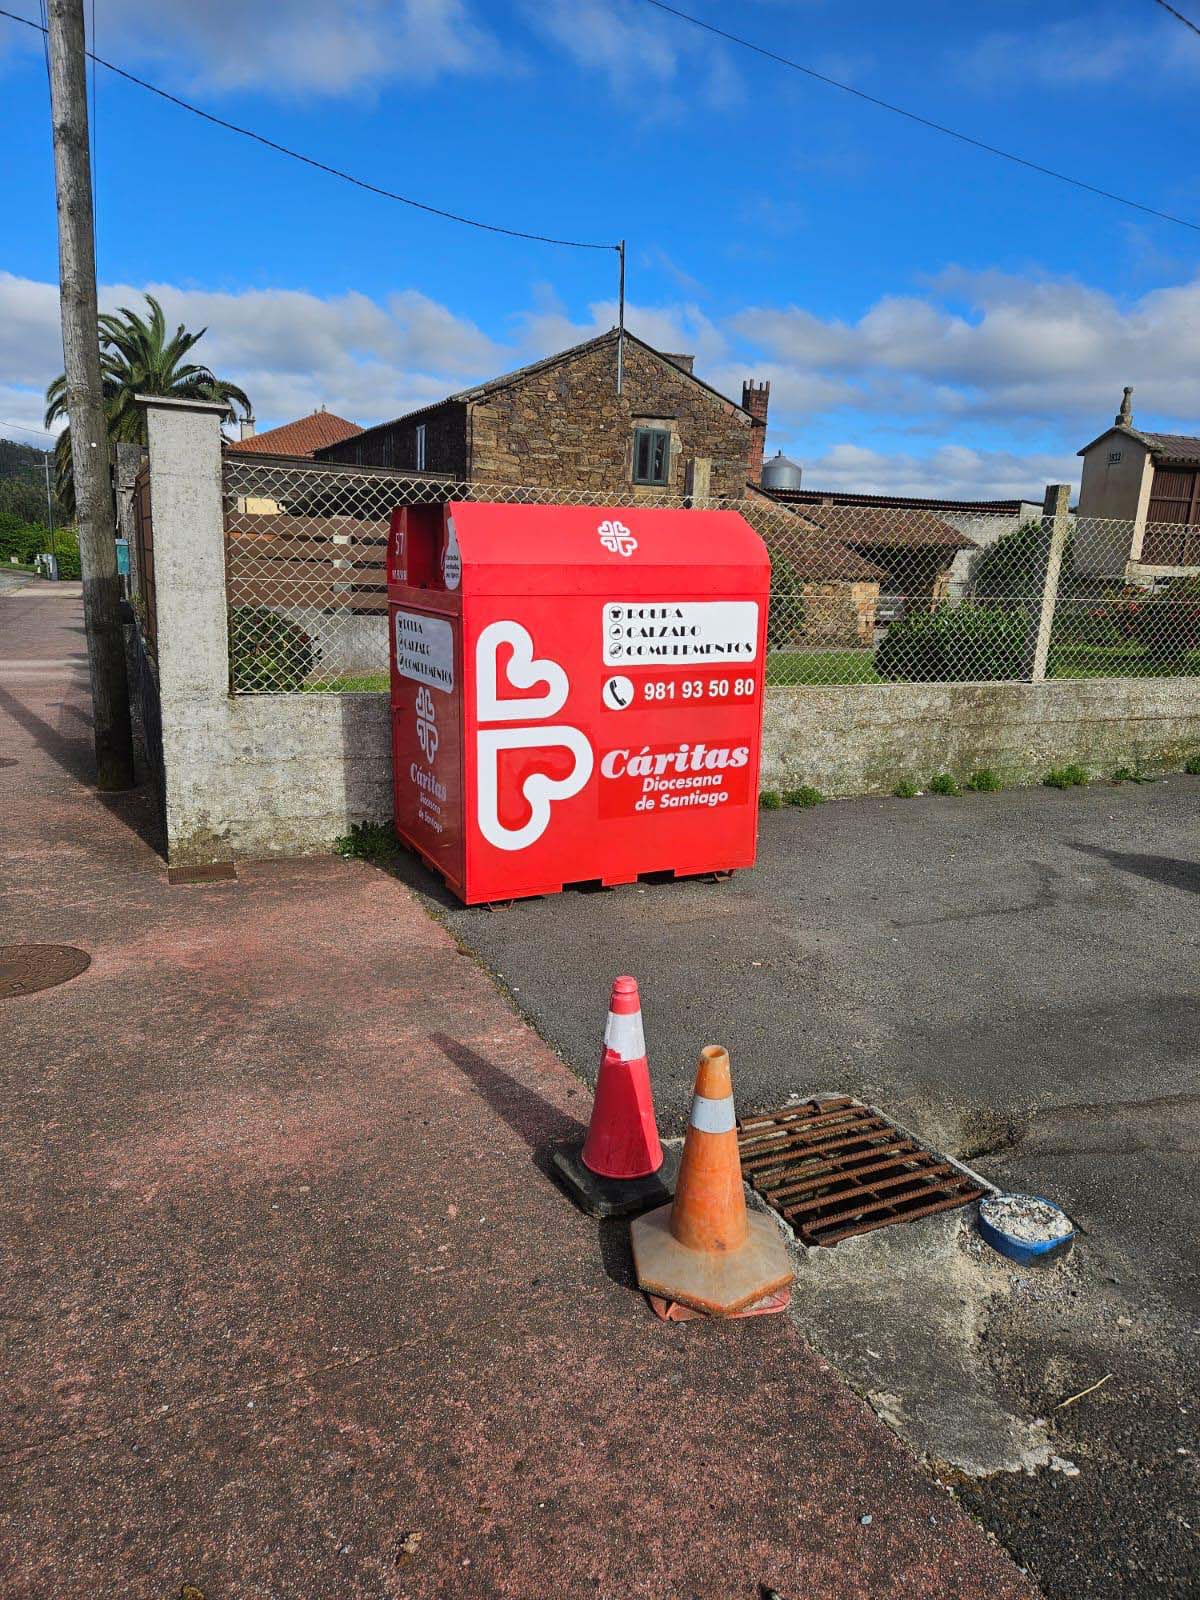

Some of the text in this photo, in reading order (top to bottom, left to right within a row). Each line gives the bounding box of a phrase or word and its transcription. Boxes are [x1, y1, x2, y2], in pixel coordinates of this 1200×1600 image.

[626, 608, 684, 619] ROUPA
[626, 625, 701, 638] CALZADO
[626, 642, 753, 656] COMPLEMENTOS
[644, 678, 755, 700] 981 93 50 80
[600, 743, 750, 779] Cáritas
[410, 763, 447, 802] Cáritas
[642, 774, 723, 793] Diocesana
[635, 790, 728, 811] de Santiago
